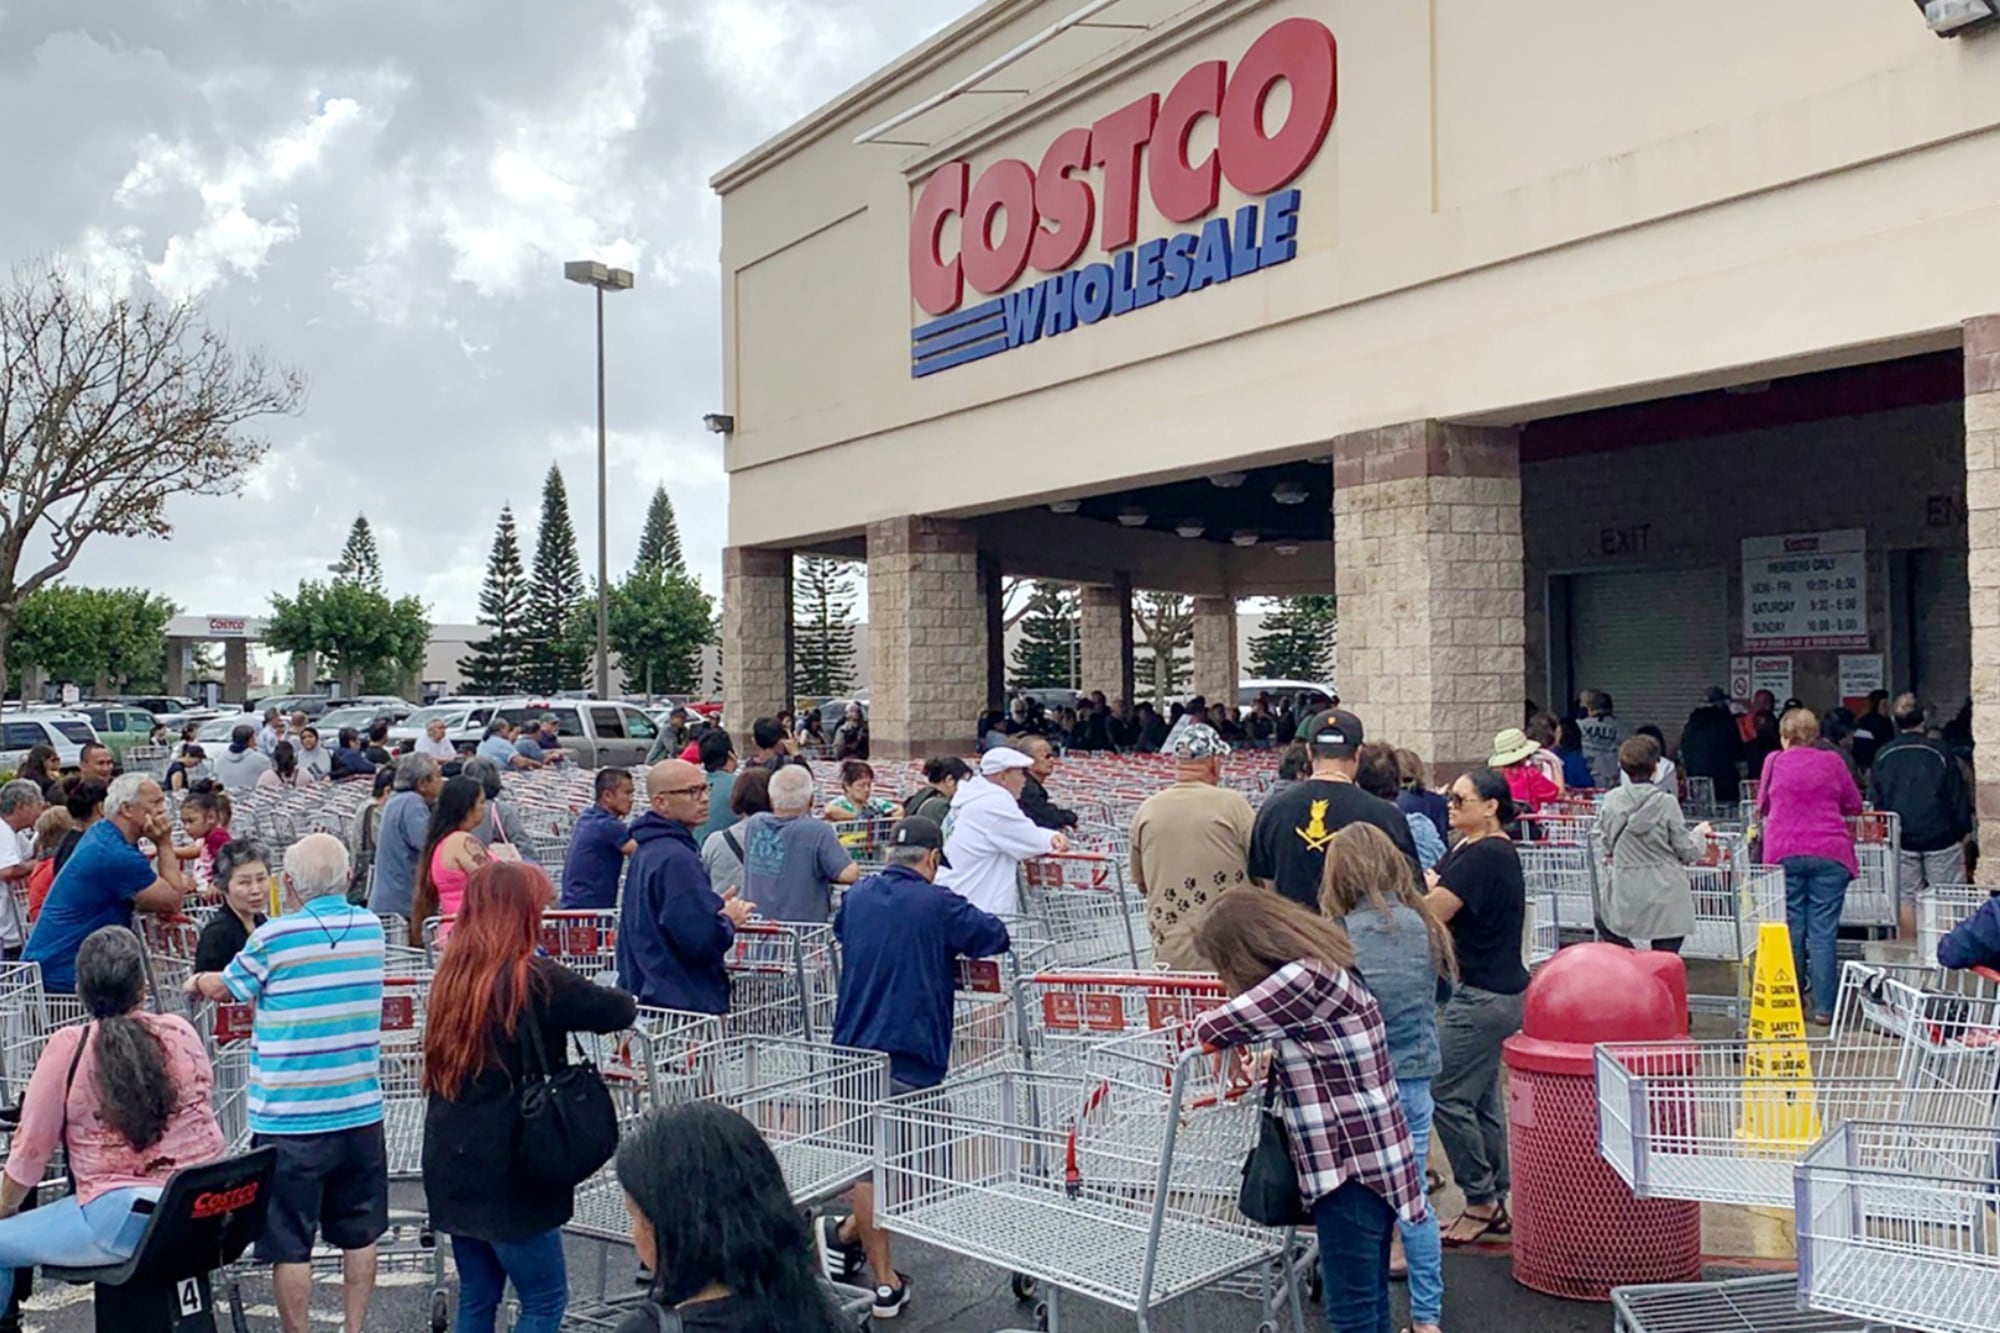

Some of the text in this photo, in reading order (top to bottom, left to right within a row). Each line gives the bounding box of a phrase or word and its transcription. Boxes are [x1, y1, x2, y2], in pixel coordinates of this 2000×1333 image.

[909, 17, 1338, 316] COSTCO
[999, 188, 1301, 349] WHOLESALE
[1600, 523, 1651, 555] EXIT
[1812, 557, 1836, 571] ONLY
[1752, 600, 1796, 615] SATURDAY
[210, 618, 245, 630] COSTCO
[1752, 620, 1786, 634] SUNDAY
[1770, 985, 1795, 995] CAUTION
[1770, 1021, 1800, 1032] SAFETY
[193, 1182, 259, 1212] COSTCO
[182, 1280, 199, 1311] 4
